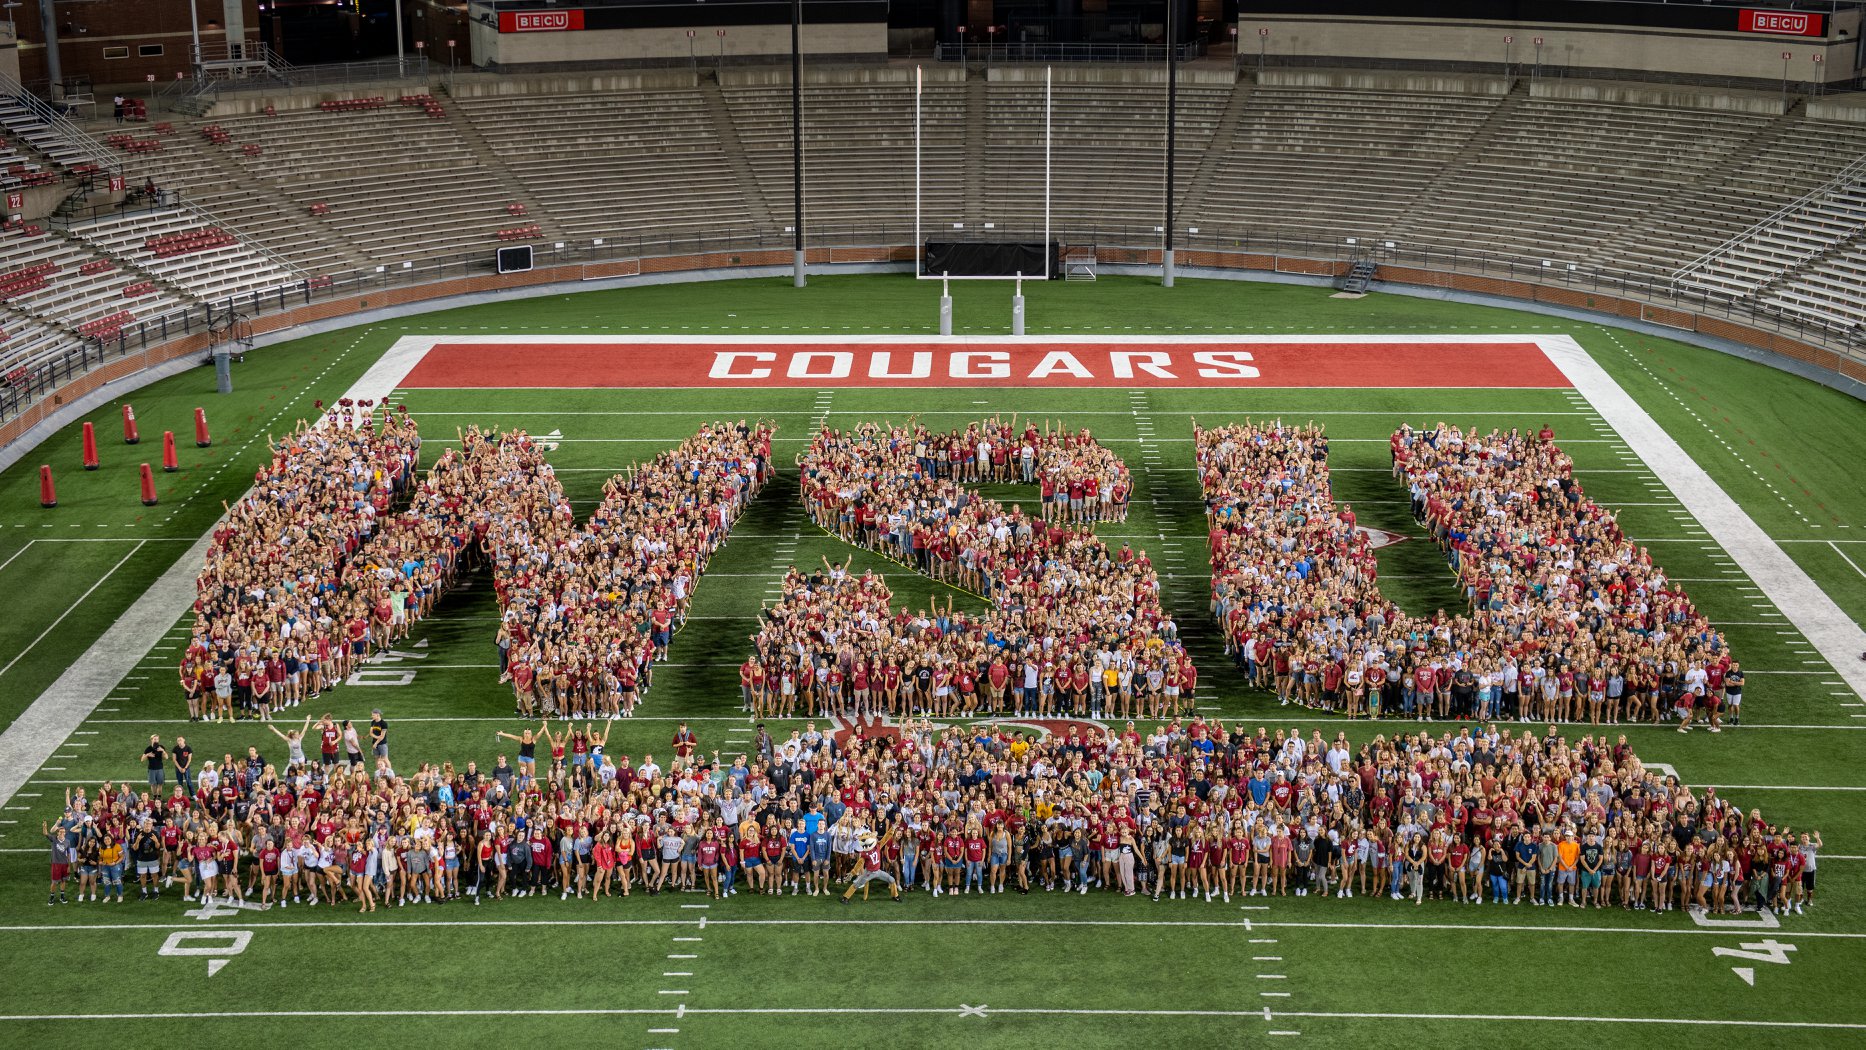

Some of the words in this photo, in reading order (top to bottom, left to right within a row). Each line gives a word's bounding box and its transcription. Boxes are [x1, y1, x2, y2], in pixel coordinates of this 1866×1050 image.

[520, 16, 564, 27] BECU
[1757, 16, 1803, 29] BECU
[708, 351, 1261, 379] COUGARS
